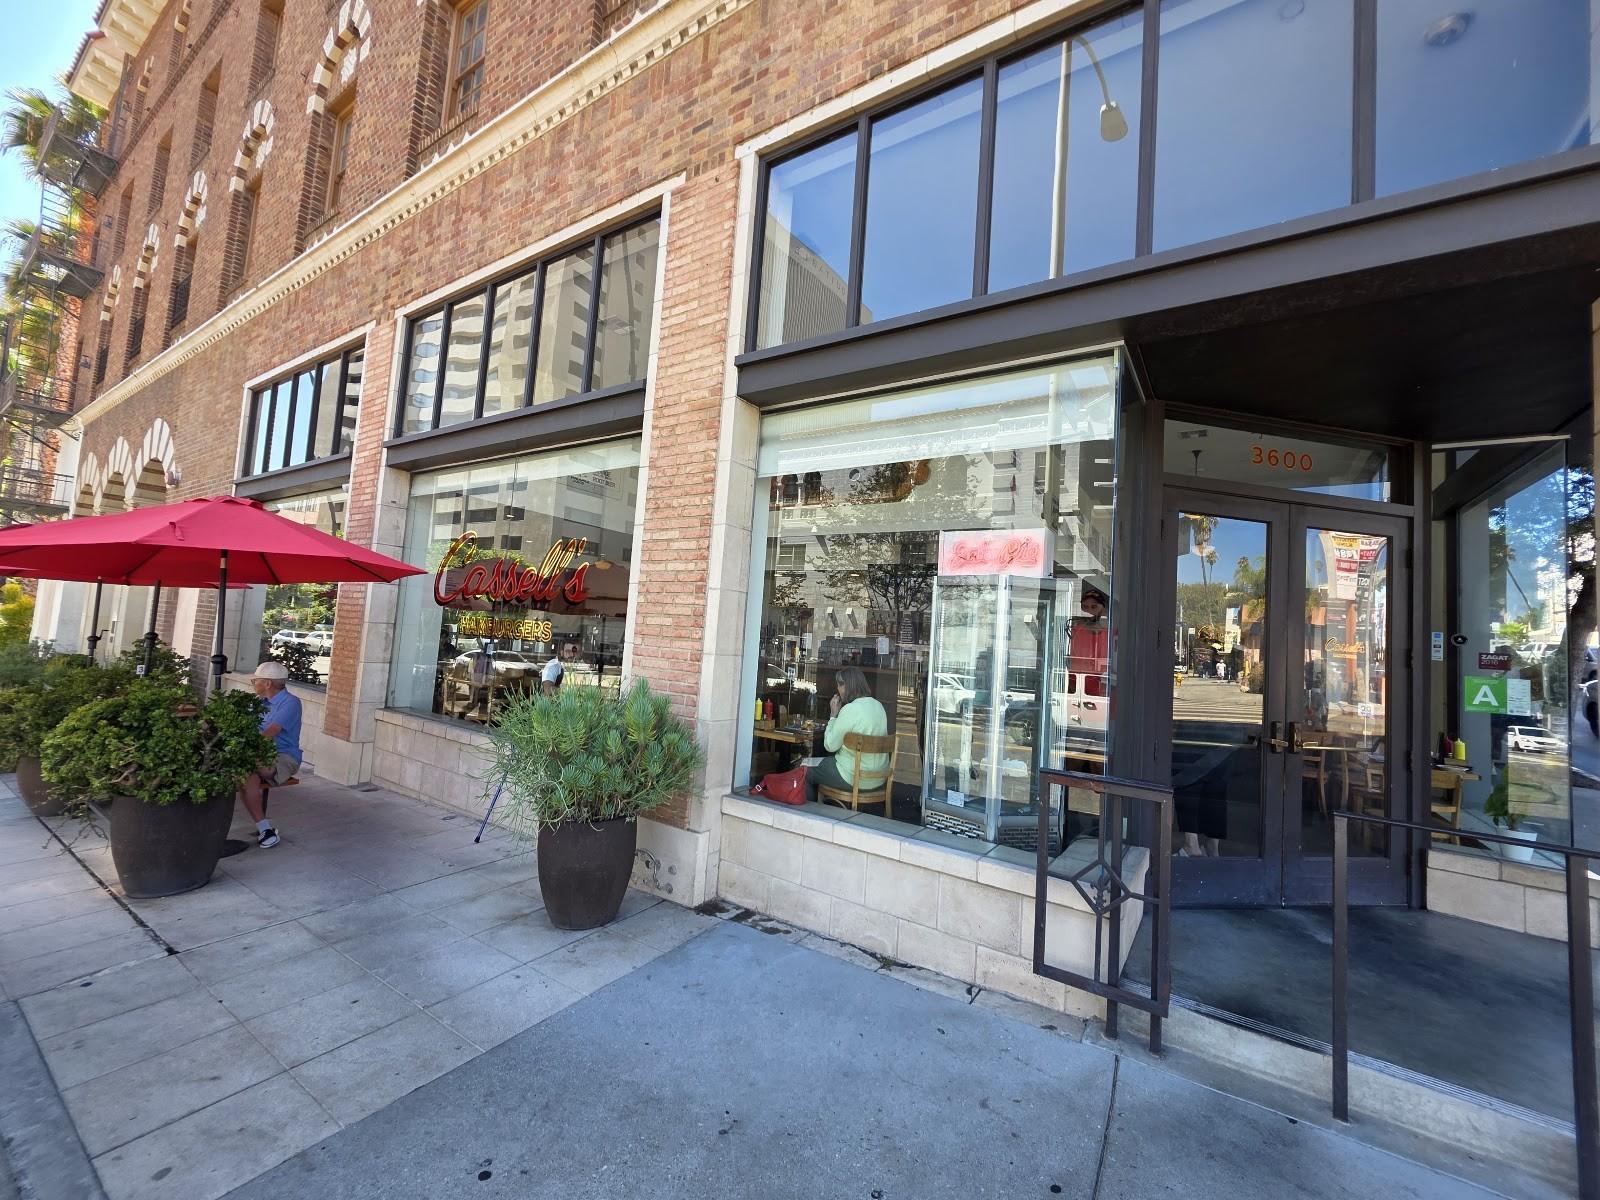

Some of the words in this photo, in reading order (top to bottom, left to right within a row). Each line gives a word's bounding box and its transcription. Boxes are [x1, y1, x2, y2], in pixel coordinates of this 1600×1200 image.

[1251, 446, 1313, 472] 3600
[949, 539, 988, 568] Eat
[998, 536, 1039, 569] Pie
[434, 530, 590, 606] Cassell's
[459, 615, 552, 643] HAMBURGERS
[1472, 684, 1499, 706] A
